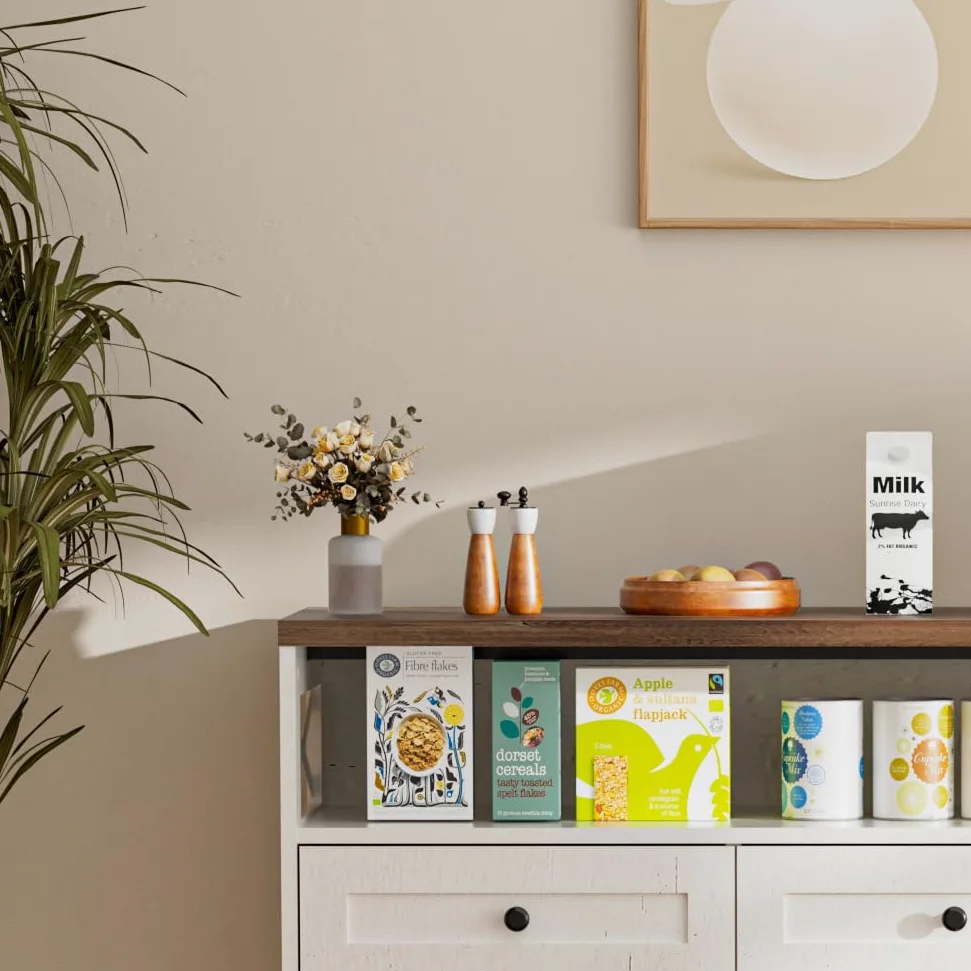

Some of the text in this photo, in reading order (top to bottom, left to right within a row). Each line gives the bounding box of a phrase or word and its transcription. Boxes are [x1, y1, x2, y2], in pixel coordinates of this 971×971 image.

[873, 476, 925, 493] Milk
[869, 499, 926, 509] Sunrise Dairy
[405, 660, 459, 672] Fibre flakes
[633, 677, 674, 692] Apple
[632, 693, 698, 705] & sultana
[633, 708, 688, 723] flapjack
[496, 748, 542, 761] dorset
[496, 763, 547, 776] cereals
[497, 779, 553, 788] tasty toasted
[497, 788, 546, 799] spelt flakes
